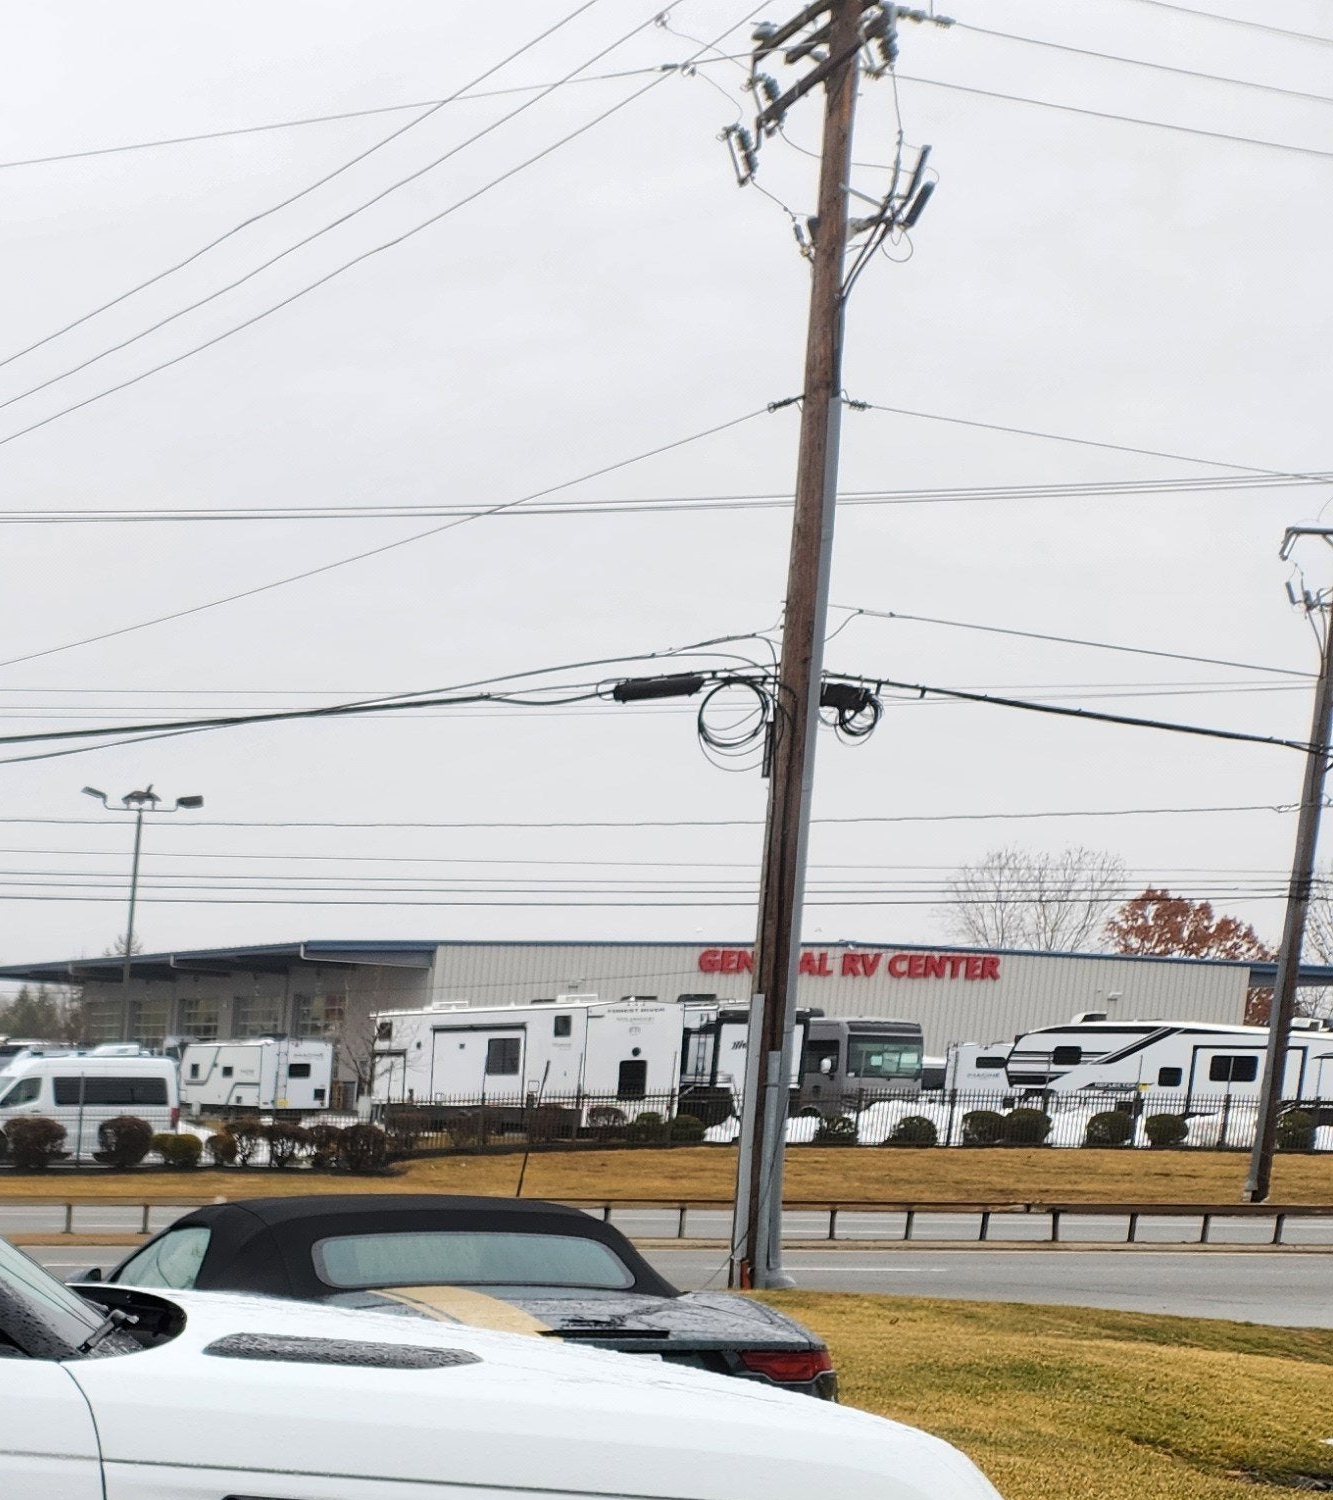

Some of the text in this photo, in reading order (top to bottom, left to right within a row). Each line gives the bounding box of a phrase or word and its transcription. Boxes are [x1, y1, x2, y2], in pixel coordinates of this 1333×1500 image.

[698, 949, 1002, 981] GENAL RV CENTER
